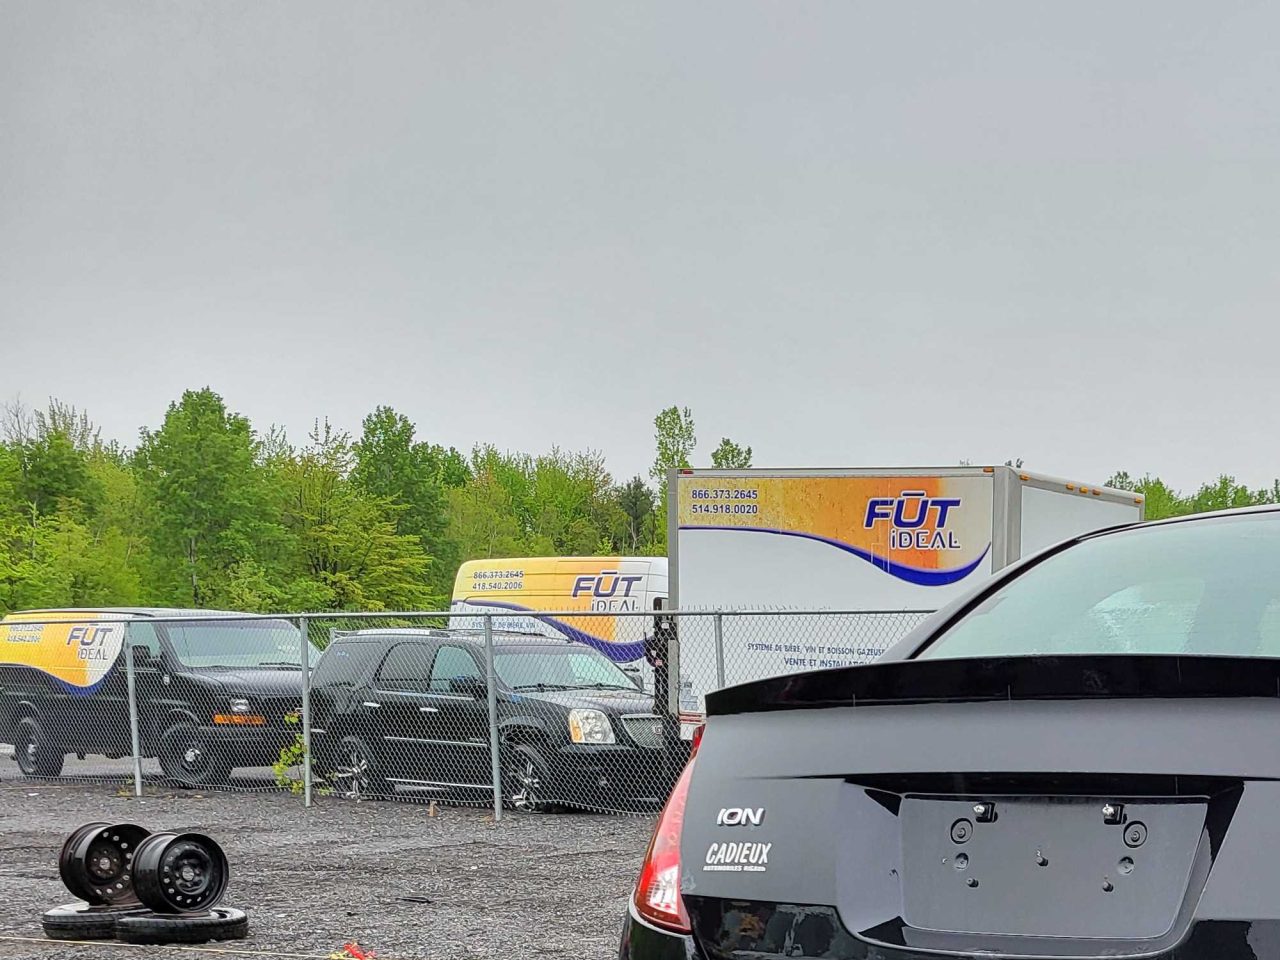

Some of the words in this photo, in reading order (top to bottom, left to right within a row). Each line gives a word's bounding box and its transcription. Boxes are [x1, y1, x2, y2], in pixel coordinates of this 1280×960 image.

[691, 489, 758, 500] 866.373.2645
[692, 504, 758, 514] 514.918.0020
[473, 571, 524, 580] 866.373.2645
[472, 582, 523, 590] 418.540.2006
[818, 646, 825, 654] ET
[827, 647, 855, 655] BOISSON
[784, 657, 806, 667] VENTE
[809, 658, 817, 667] ET
[716, 807, 766, 827] ION
[705, 842, 772, 864] CADIEUX
